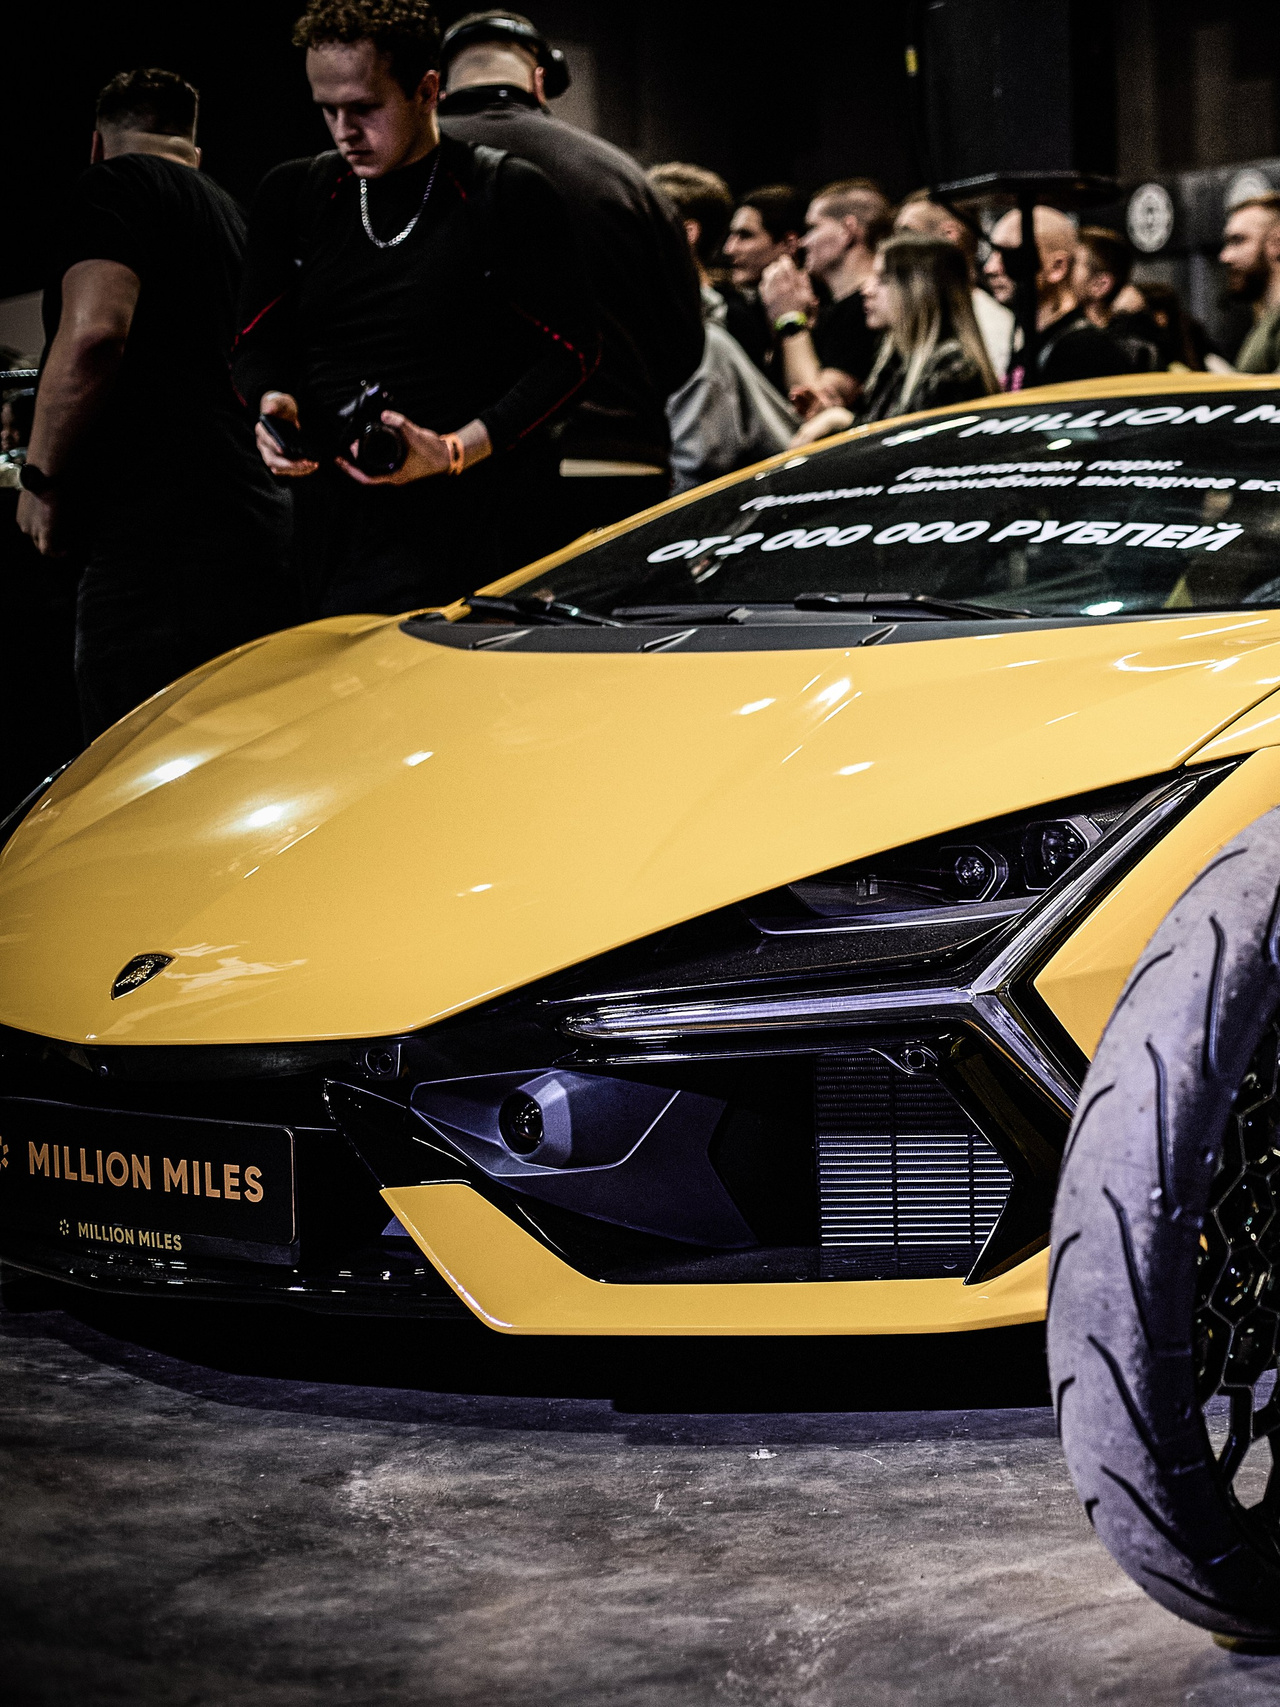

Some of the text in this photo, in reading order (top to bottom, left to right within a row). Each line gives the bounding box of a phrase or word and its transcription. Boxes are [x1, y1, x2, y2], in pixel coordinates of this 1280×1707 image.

[957, 404, 1237, 438] MILLION
[887, 473, 1077, 495] автомобили
[1077, 475, 1237, 489] выгоднее
[646, 520, 1245, 563] ОТ 2 000 000 РУБЛЕЙ
[28, 1141, 265, 1203] MILLION MILES
[77, 1221, 183, 1251] MILLION MILES
